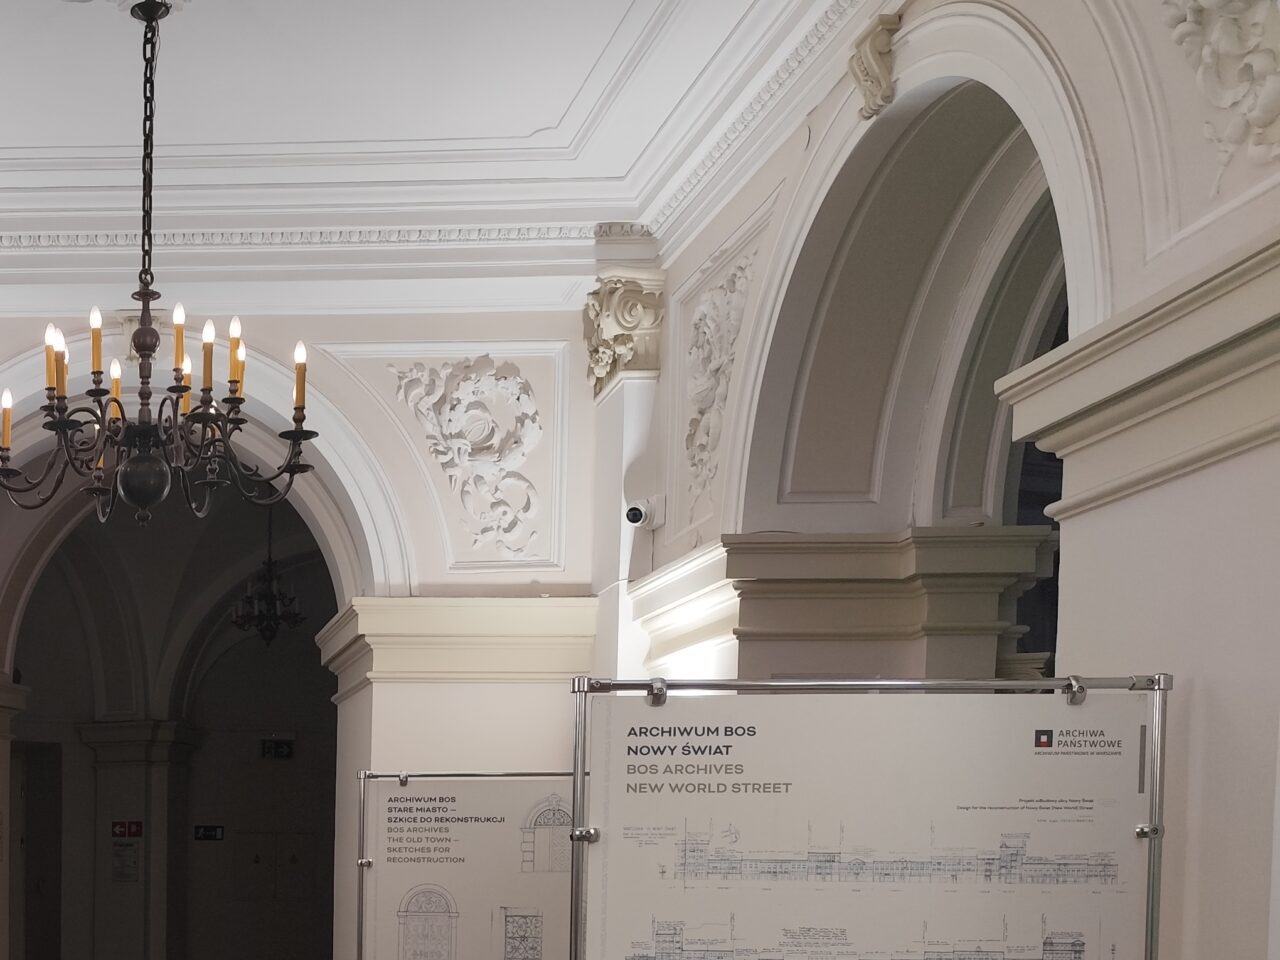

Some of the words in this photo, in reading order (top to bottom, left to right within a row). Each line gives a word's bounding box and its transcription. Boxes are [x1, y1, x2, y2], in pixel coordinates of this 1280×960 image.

[627, 726, 720, 737] ARCHIWUM
[724, 726, 757, 736] BOS
[627, 745, 676, 756] NOWY
[681, 742, 733, 756] ŚWIAT
[1057, 740, 1122, 748] PAŃSTWOWE
[626, 764, 660, 774] BOS
[664, 764, 744, 774] ARCHIVES
[626, 783, 664, 793] NEW
[668, 783, 728, 793] WORLD
[731, 783, 793, 793] STREET
